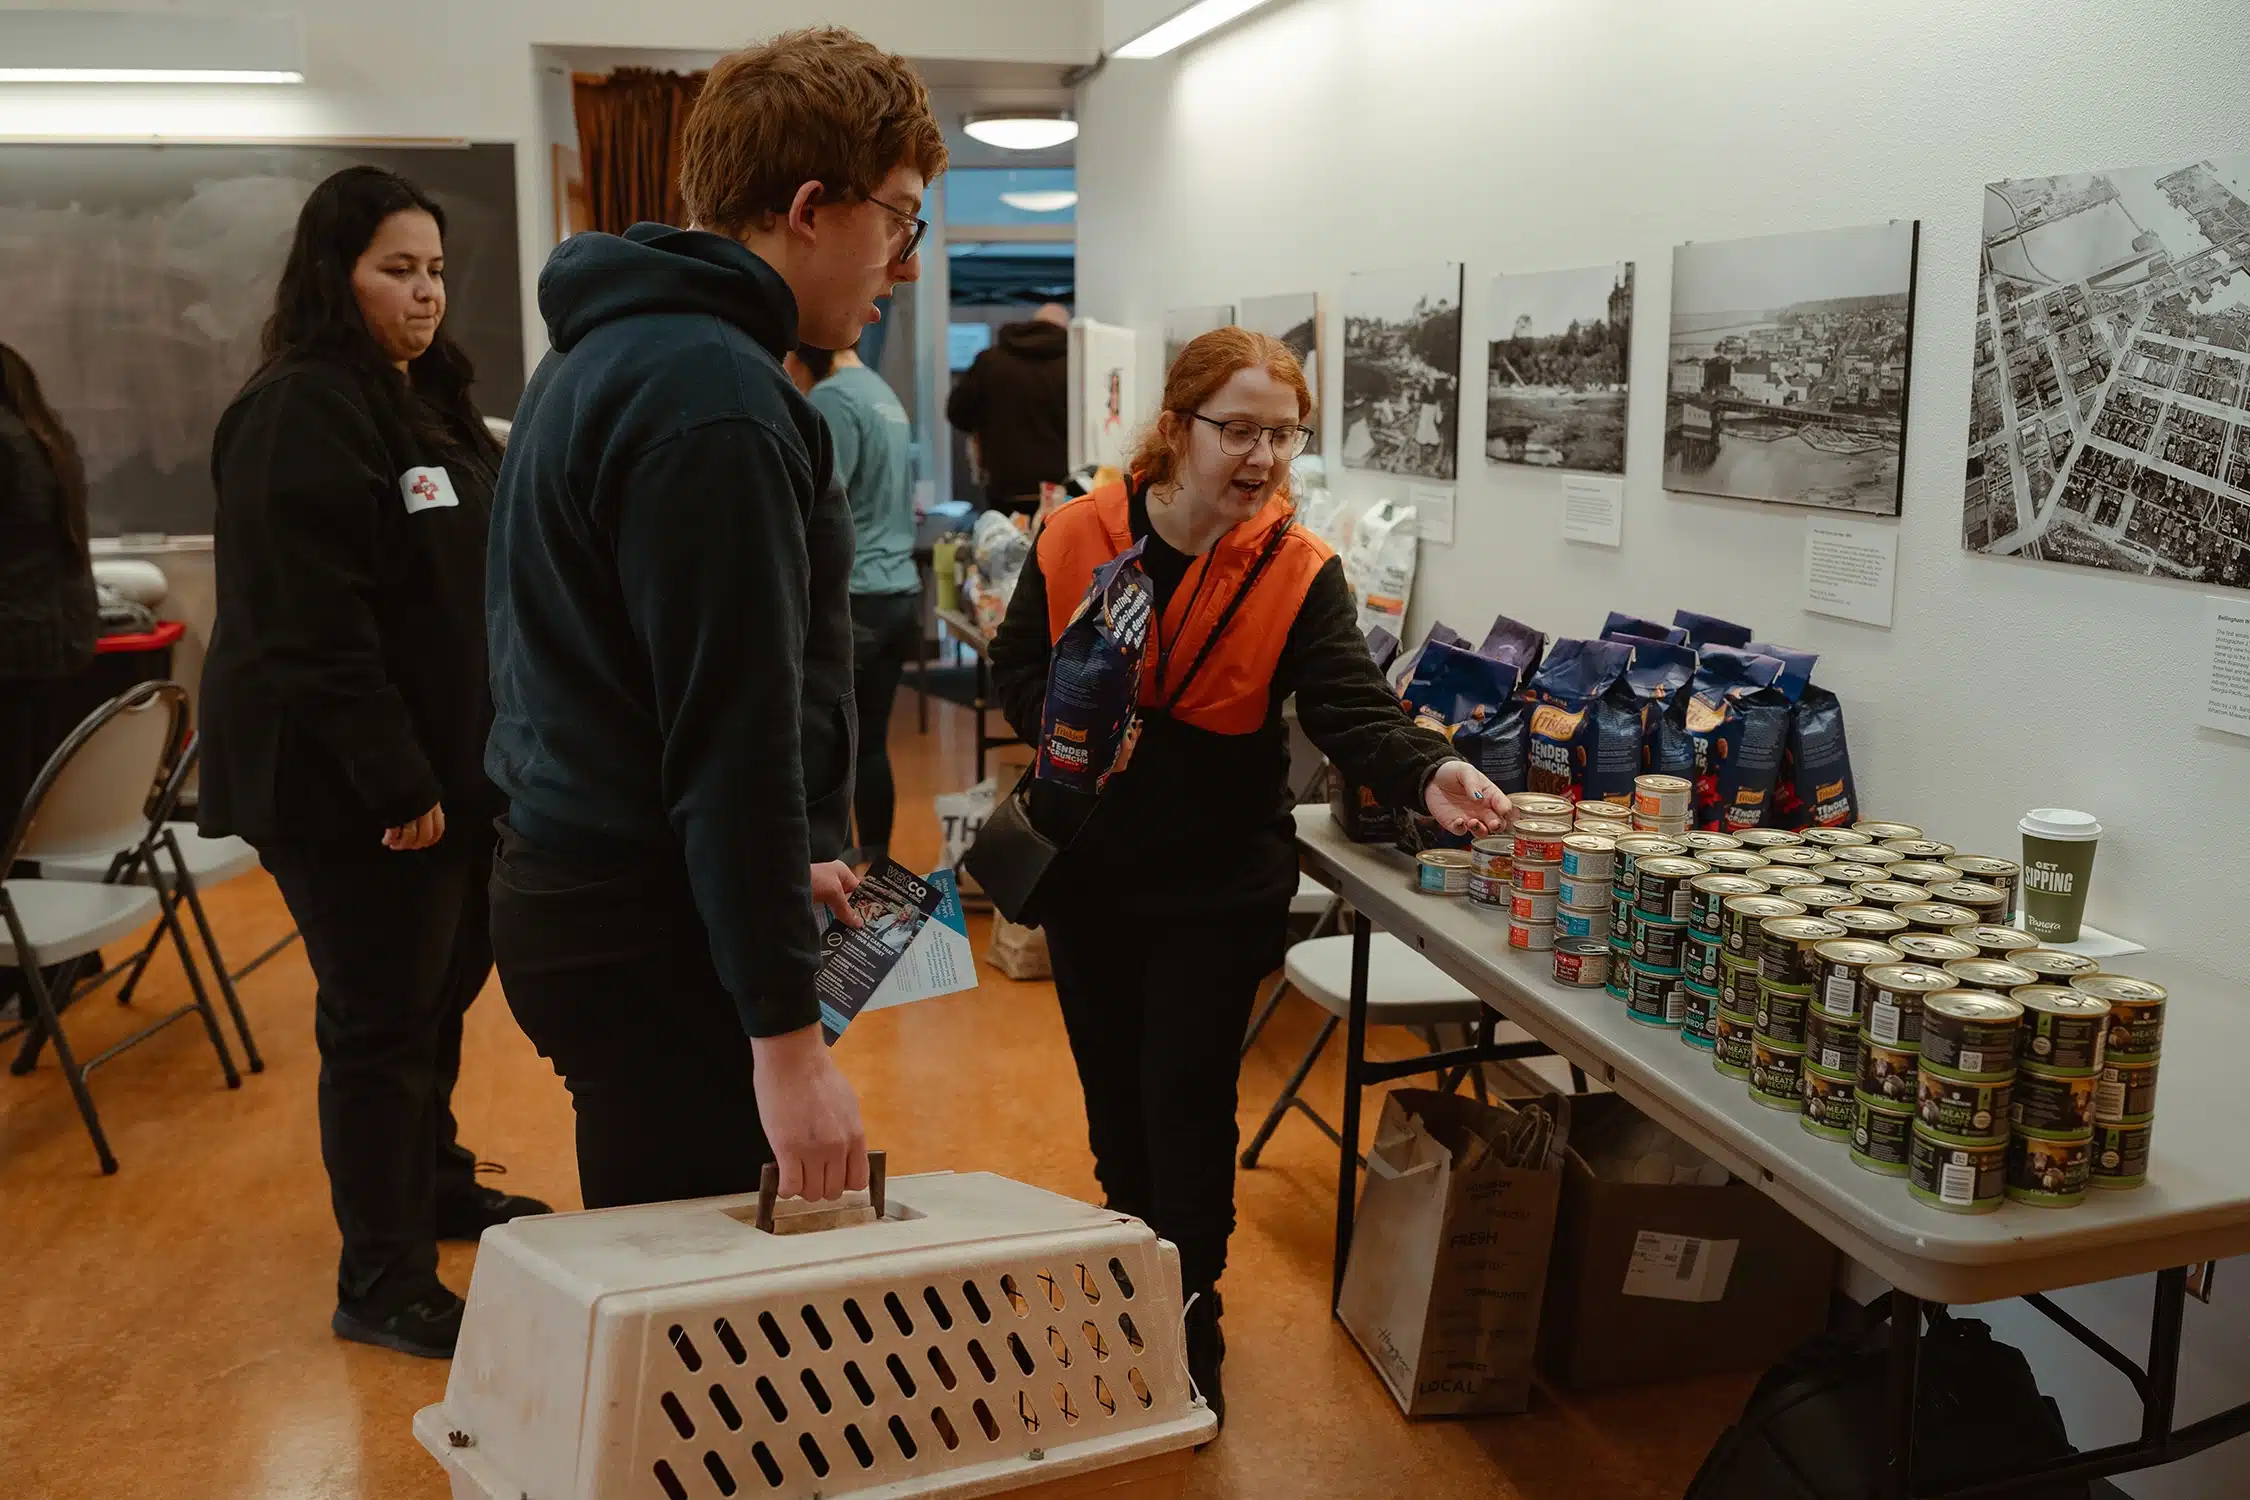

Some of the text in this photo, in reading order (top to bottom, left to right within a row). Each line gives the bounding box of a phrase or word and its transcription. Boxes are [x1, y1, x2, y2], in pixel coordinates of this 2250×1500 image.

[1049, 739, 1089, 758] TENDER
[1529, 738, 1570, 763] TENDER
[1729, 806, 1761, 818] TENDER
[1815, 797, 1848, 814] TENDER
[941, 815, 981, 842] TH
[2035, 861, 2059, 871] GET
[2025, 865, 2074, 893] SIPPING
[2028, 914, 2061, 930] Panera
[866, 942, 886, 957] BUDGET
[1767, 1080, 1793, 1090] RECIPE
[1768, 1075, 1794, 1085] MEATS
